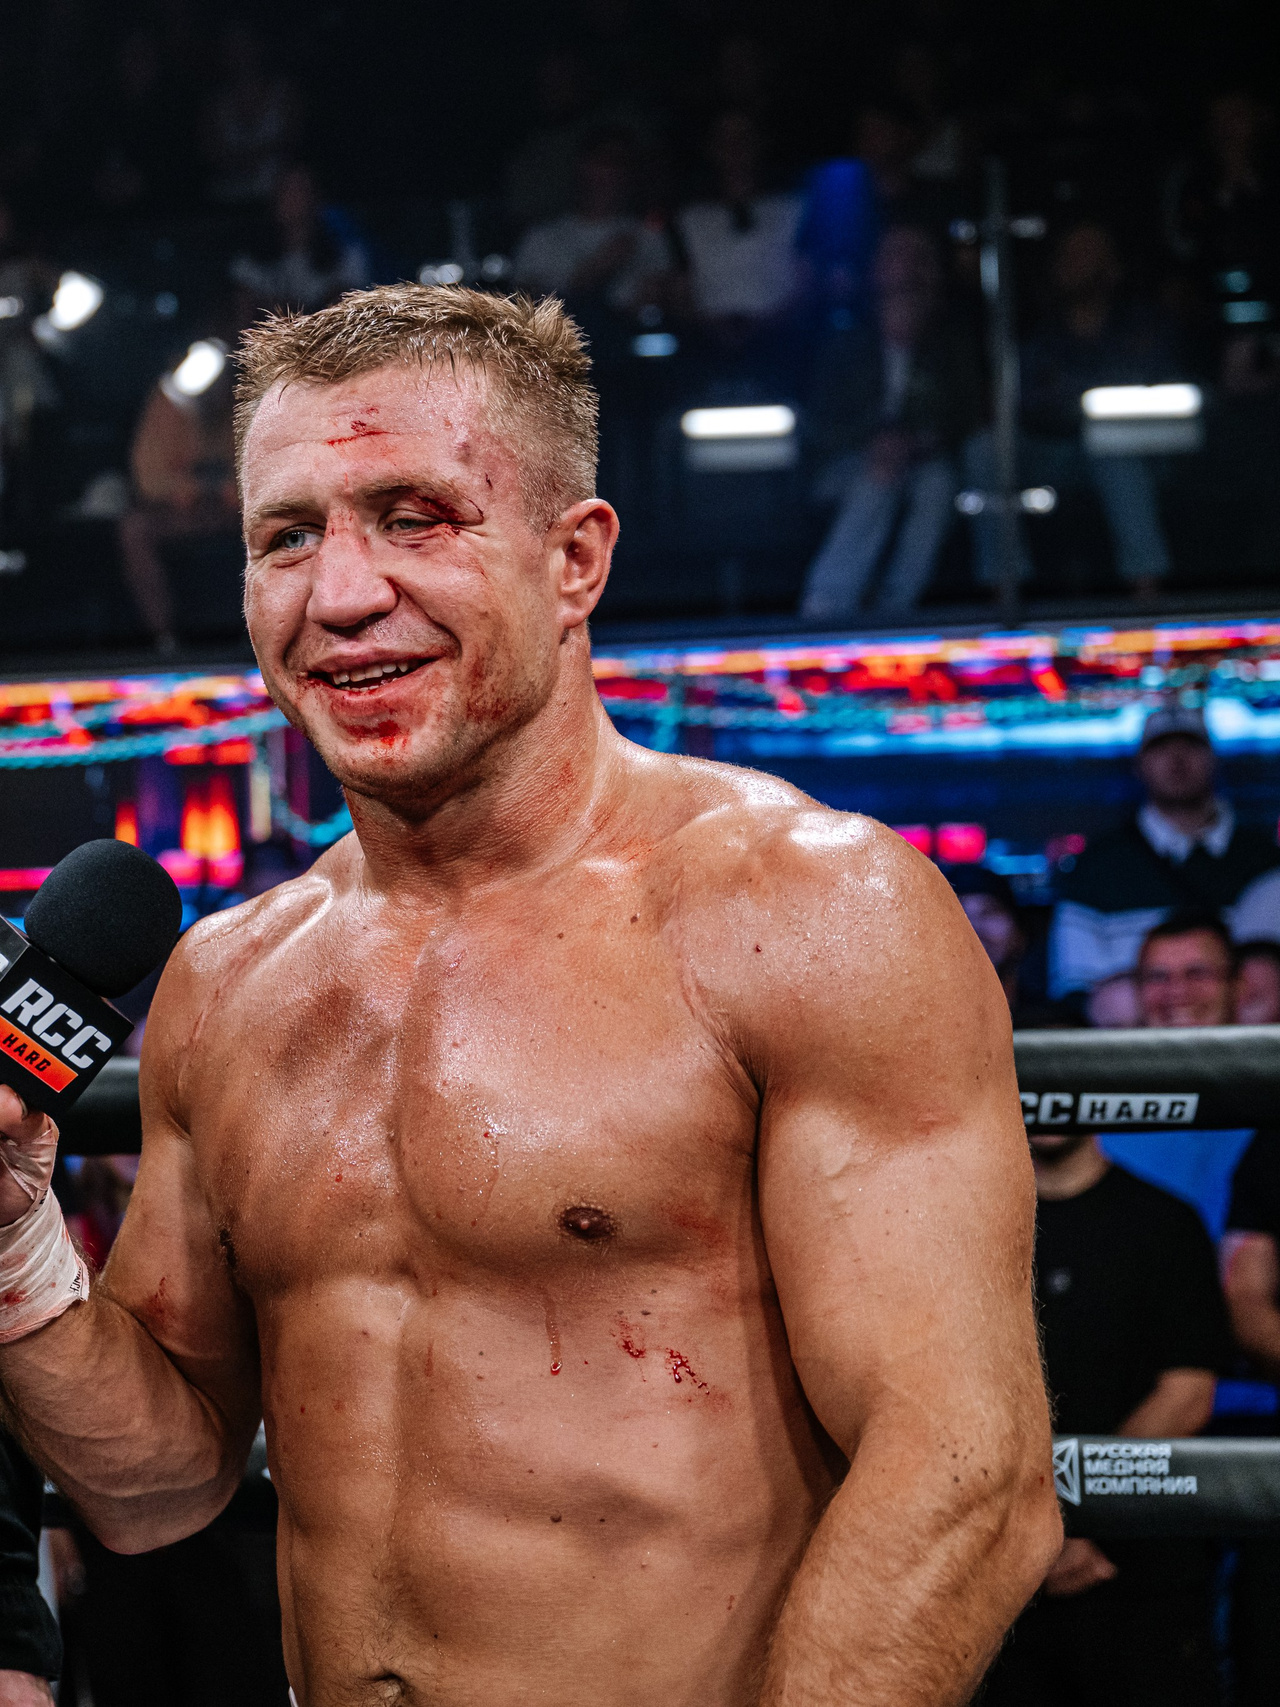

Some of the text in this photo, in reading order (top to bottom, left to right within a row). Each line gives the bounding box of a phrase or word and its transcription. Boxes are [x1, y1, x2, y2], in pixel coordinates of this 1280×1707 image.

[0, 977, 112, 1070] RCC
[2, 1032, 52, 1073] HARD
[1082, 1443, 1172, 1459] РУССКАЯ
[1083, 1459, 1170, 1476] МЕДНАЯ
[1084, 1475, 1198, 1495] КОМПАНИЯ
